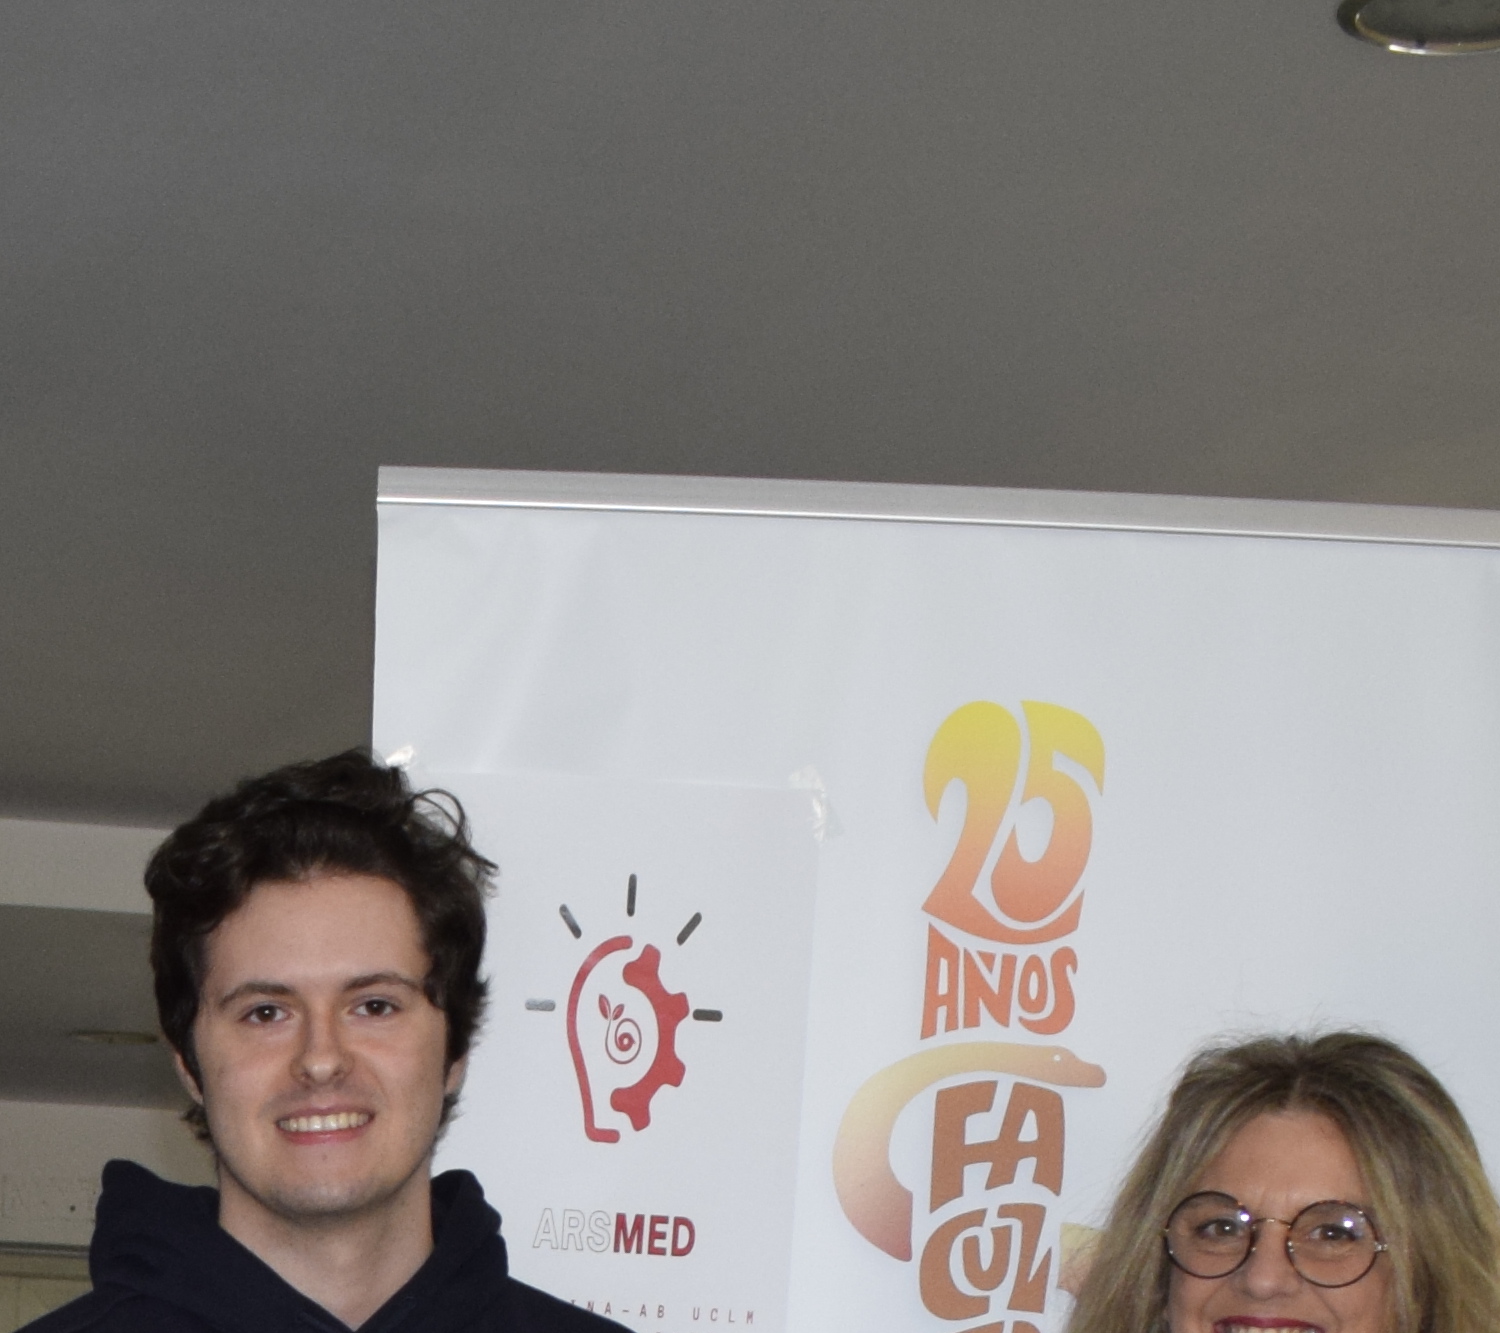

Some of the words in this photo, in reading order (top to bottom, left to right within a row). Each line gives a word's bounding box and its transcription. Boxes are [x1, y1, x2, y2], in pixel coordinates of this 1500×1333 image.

[921, 699, 1106, 945] 25
[920, 921, 1078, 1041] AÑOS
[532, 1207, 696, 1257] ARSMED
